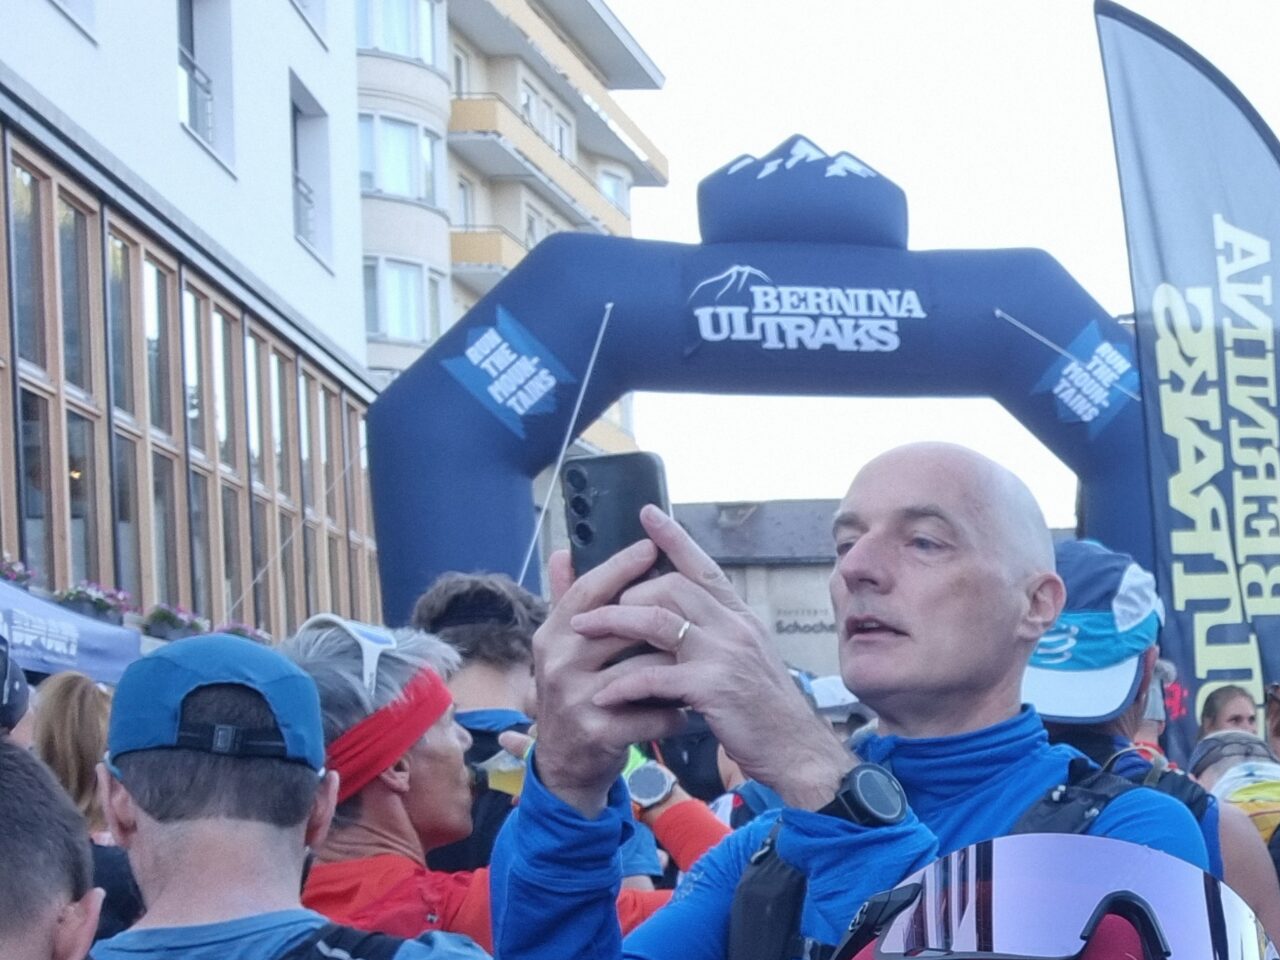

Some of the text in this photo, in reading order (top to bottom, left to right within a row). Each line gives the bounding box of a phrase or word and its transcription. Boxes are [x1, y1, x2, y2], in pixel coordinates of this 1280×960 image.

[750, 285, 927, 318] BERNINA
[694, 306, 900, 352] ULTRAKS
[1086, 355, 1120, 388] THE
[1095, 342, 1131, 374] RUN
[1053, 378, 1099, 422] TAINS
